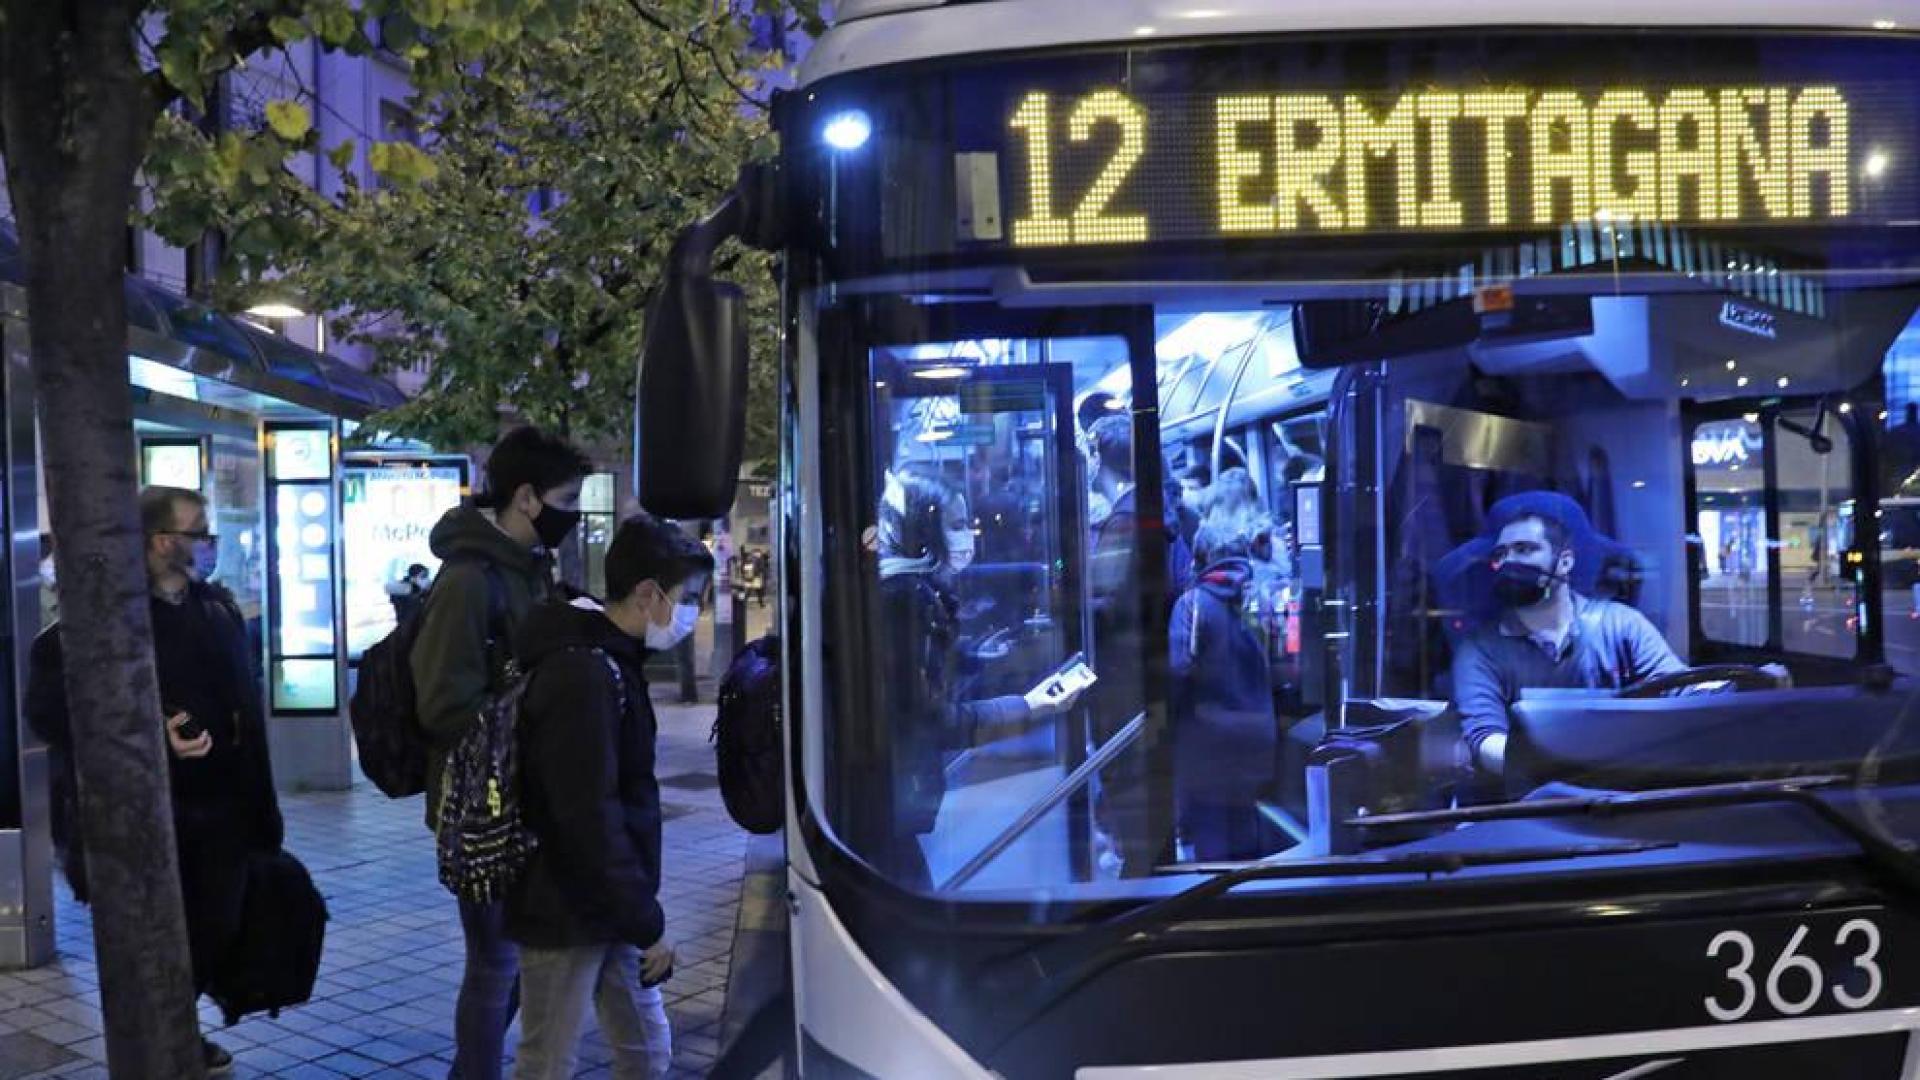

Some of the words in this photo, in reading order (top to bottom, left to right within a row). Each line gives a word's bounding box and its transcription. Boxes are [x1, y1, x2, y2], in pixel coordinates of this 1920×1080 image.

[1009, 91, 1148, 247] 12
[1216, 86, 1849, 231] ERMITAGAÑA
[1704, 918, 1882, 1022] 363
